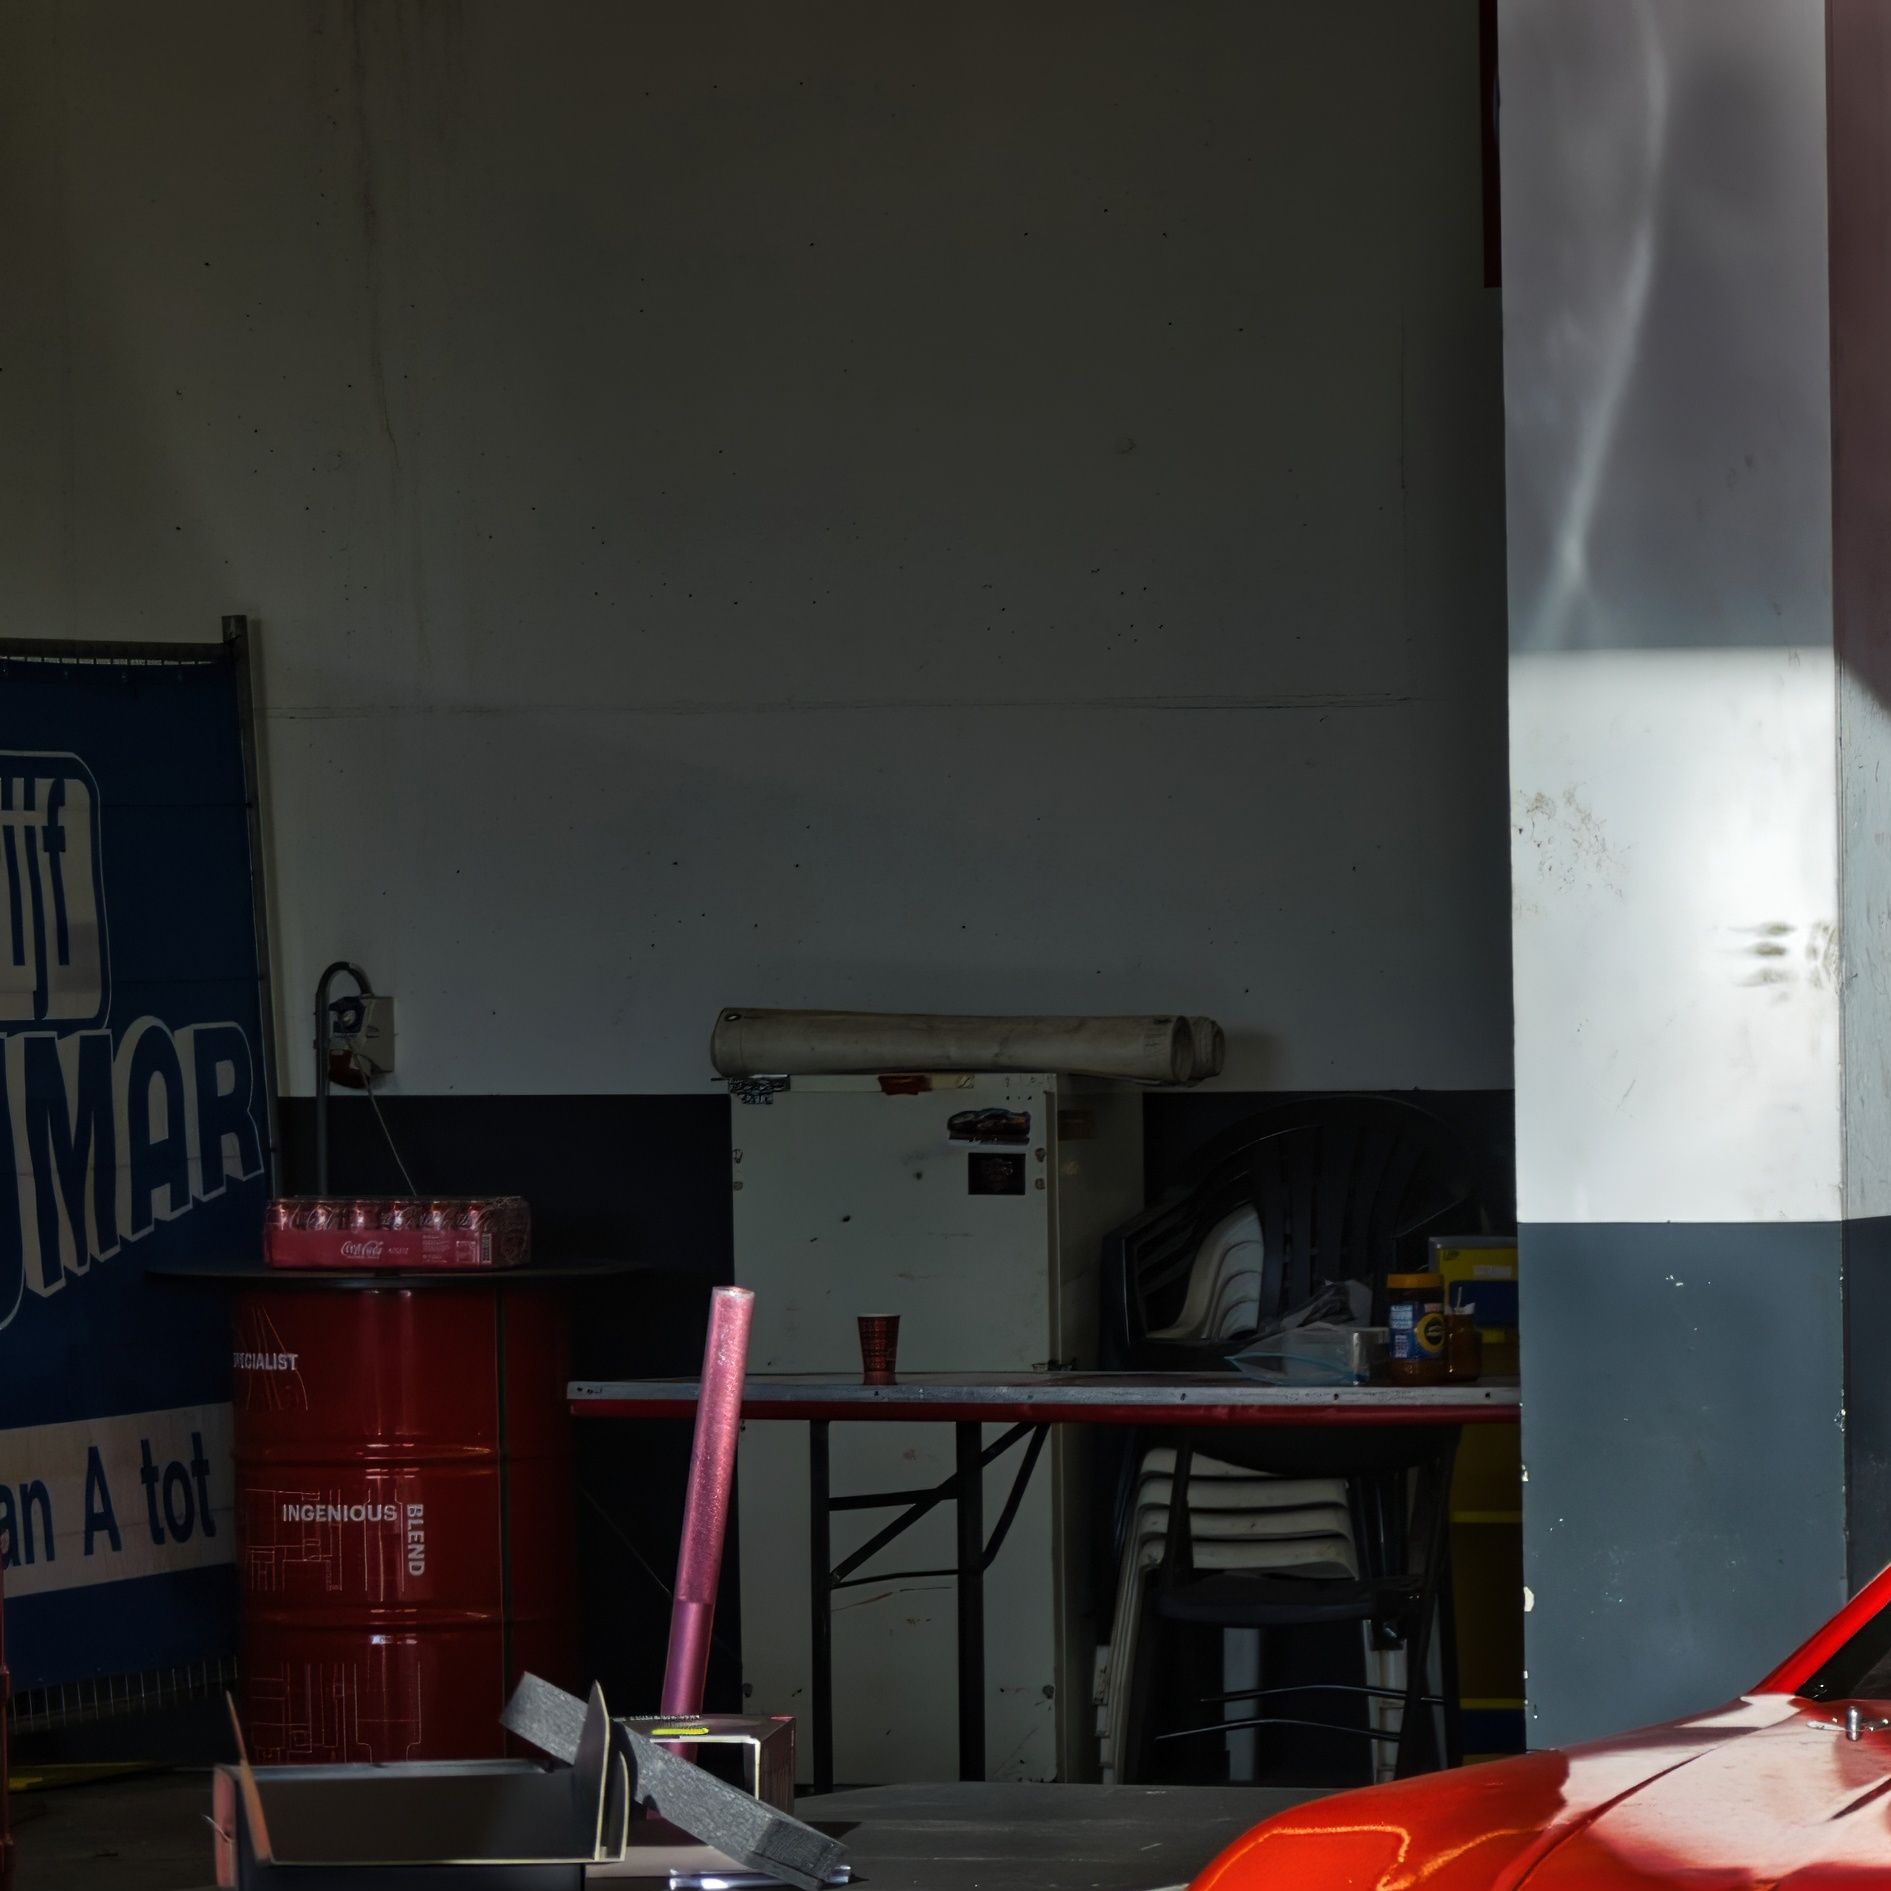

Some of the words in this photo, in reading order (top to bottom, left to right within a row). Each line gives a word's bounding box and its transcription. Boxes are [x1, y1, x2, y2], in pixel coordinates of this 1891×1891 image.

[0, 1018, 264, 1330] MAR
[84, 1446, 122, 1556] A
[140, 1432, 217, 1546] tot
[281, 1504, 398, 1522] INGENIOUS
[407, 1503, 426, 1577] BLEND
